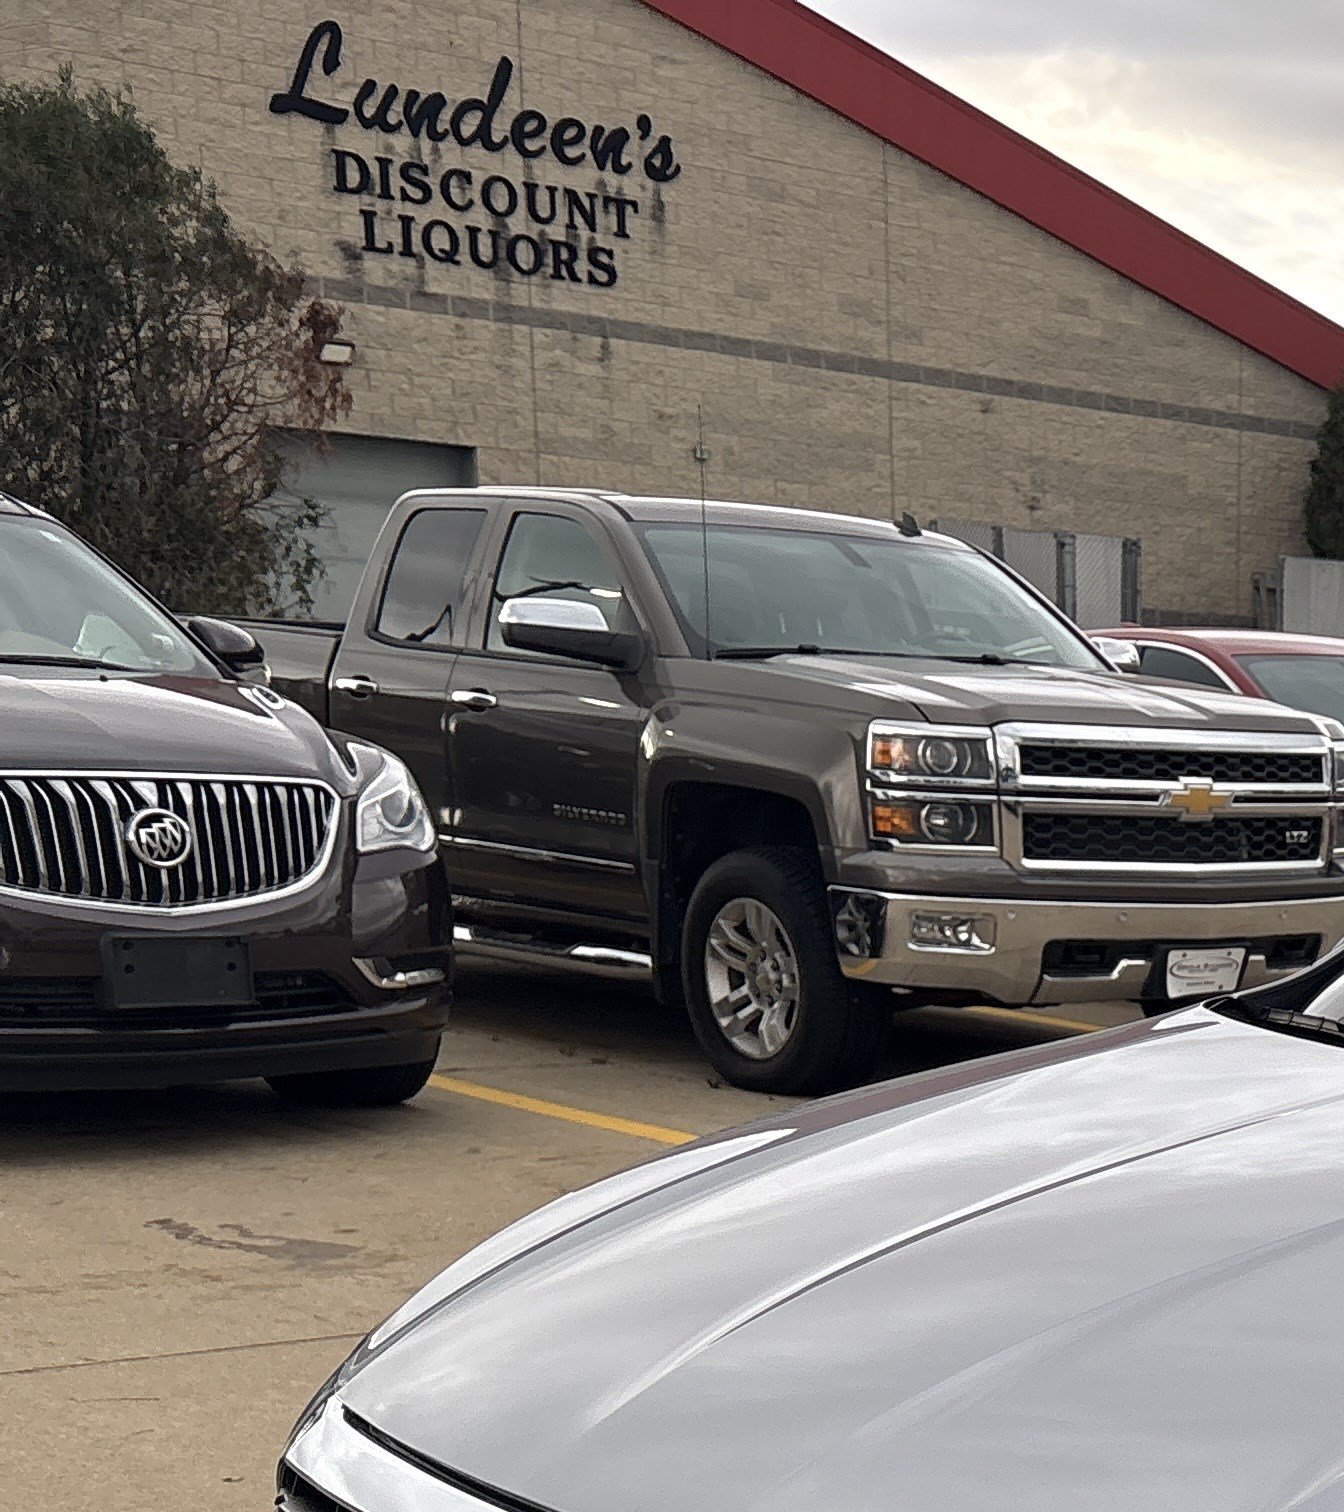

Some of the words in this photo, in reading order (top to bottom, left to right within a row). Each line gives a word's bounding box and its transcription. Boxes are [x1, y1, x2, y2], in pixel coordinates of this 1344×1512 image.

[269, 19, 682, 183] Lundeen's
[330, 147, 639, 240] DISCOUNT
[358, 208, 618, 288] LIQUORS
[1285, 830, 1309, 843] LTZ
